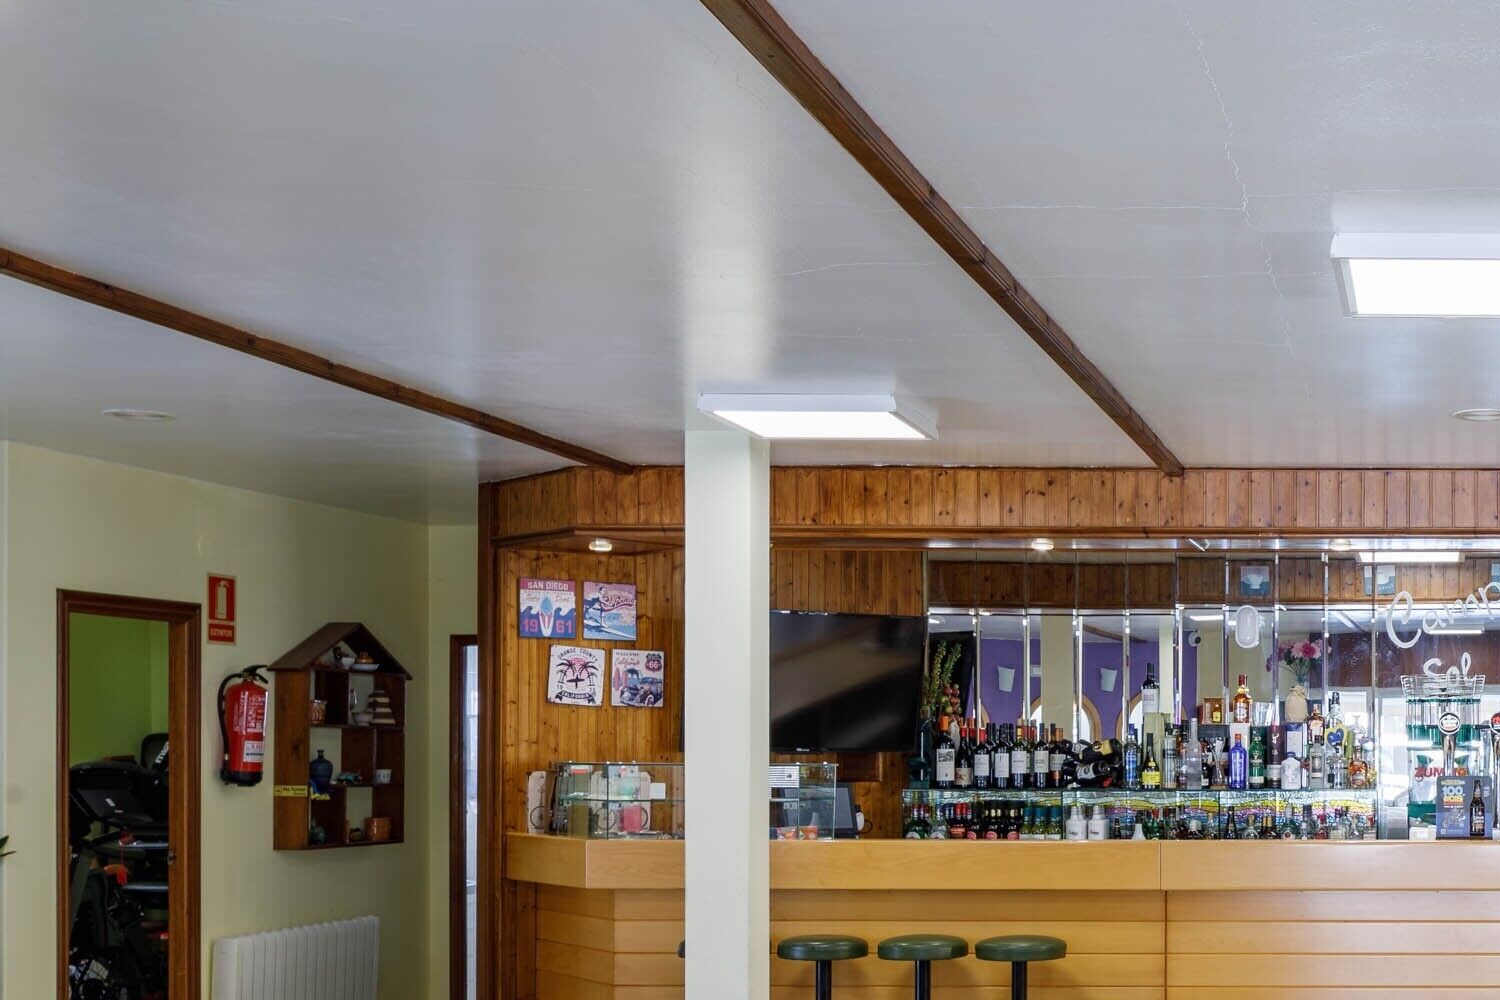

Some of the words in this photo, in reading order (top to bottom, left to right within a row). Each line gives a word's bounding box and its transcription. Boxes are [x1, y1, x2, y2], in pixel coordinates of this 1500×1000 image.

[527, 581, 544, 589] SAN
[546, 581, 569, 591] DIEGO
[1423, 652, 1476, 686] Sol
[1414, 767, 1470, 778] ZUMO
